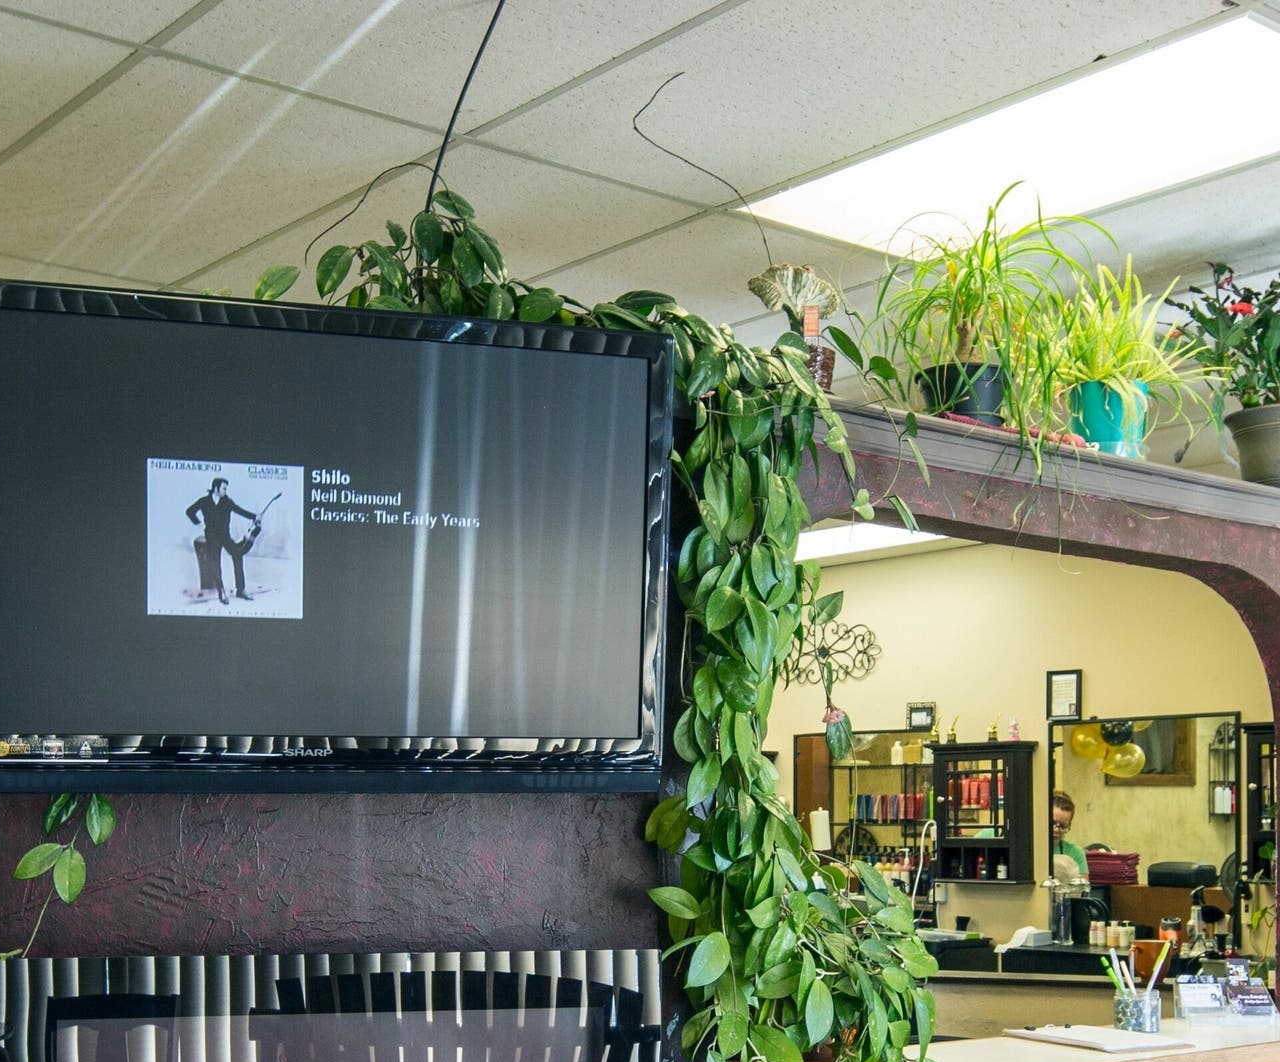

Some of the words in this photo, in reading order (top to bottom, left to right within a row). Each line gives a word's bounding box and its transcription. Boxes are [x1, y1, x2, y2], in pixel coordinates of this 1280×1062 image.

[311, 468, 351, 485] Shilo
[311, 488, 337, 503] Neil
[341, 490, 402, 506] Diamond
[310, 507, 370, 523] Classics:
[374, 510, 399, 524] The
[402, 511, 437, 529] Early
[441, 513, 480, 528] Years
[283, 748, 333, 757] SHARP
